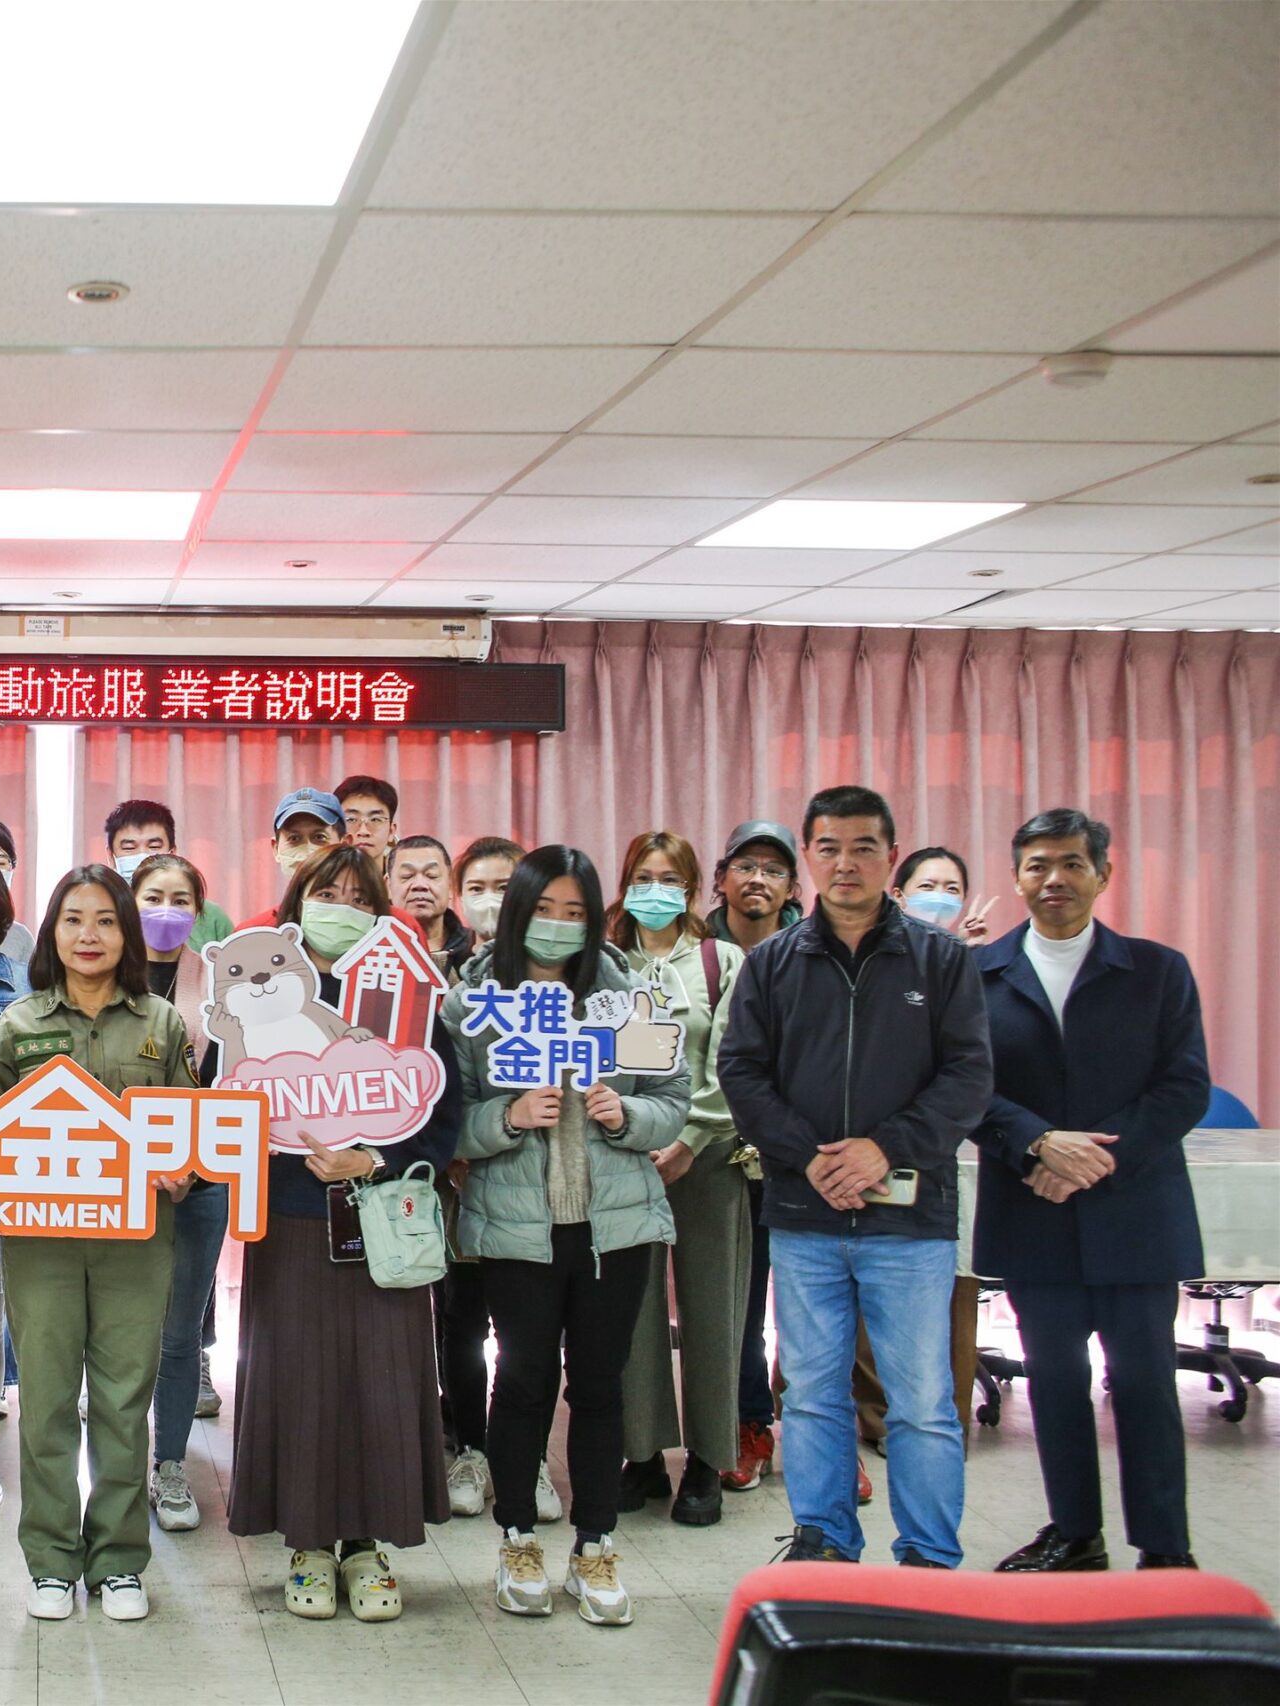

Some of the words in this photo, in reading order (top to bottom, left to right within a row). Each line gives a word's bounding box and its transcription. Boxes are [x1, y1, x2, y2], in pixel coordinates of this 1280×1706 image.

[161, 669, 415, 721] 業者說明會
[466, 984, 568, 1034] 大推
[493, 1036, 593, 1087] 金門
[231, 1066, 420, 1119] INMEN
